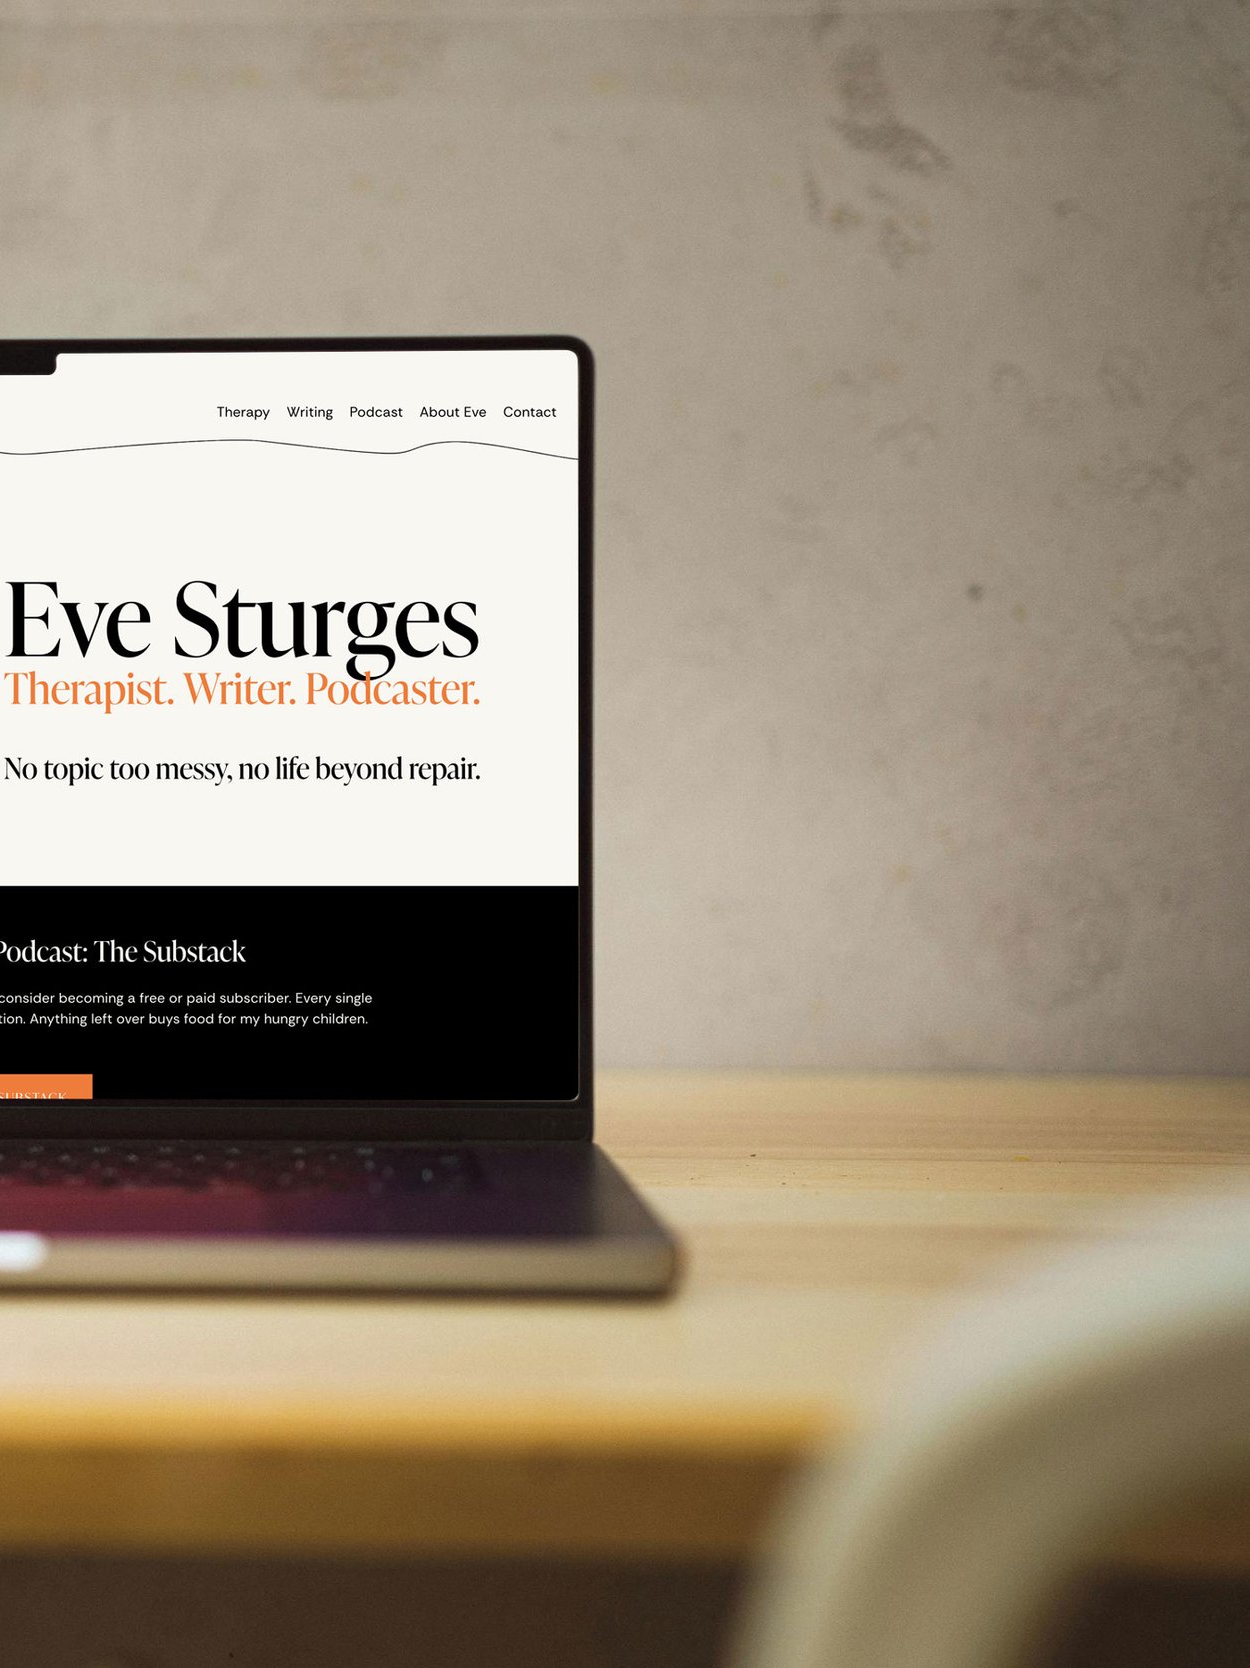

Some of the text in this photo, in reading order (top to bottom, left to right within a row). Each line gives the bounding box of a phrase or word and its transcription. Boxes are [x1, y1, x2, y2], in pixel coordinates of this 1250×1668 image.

[216, 406, 271, 421] Therapy
[286, 405, 334, 421] Writing
[349, 406, 404, 418] Podcast
[419, 406, 487, 418] About Eve
[503, 405, 557, 418] Contact
[6, 580, 479, 682] Eve Sturges
[3, 670, 480, 715] Therapist. Writer. Podcaster.
[4, 755, 481, 787] No topic too messy, no life beyond repair.
[93, 939, 138, 963] The
[143, 939, 247, 963] Substack
[58, 992, 124, 1007] becoming
[127, 994, 136, 1004] a
[139, 992, 166, 1004] free
[168, 994, 183, 1004] or
[186, 992, 216, 1007] paid
[219, 992, 292, 1004] subscriber.
[295, 992, 332, 1007] Every
[335, 992, 373, 1007] single
[29, 1012, 88, 1028] Anything
[91, 1012, 113, 1025] left
[116, 1015, 145, 1025] over
[148, 1013, 180, 1027] buys
[183, 1012, 214, 1025] food
[217, 1012, 237, 1025] for
[240, 1015, 261, 1027] my
[264, 1012, 309, 1028] hungry
[312, 1012, 368, 1025] children.
